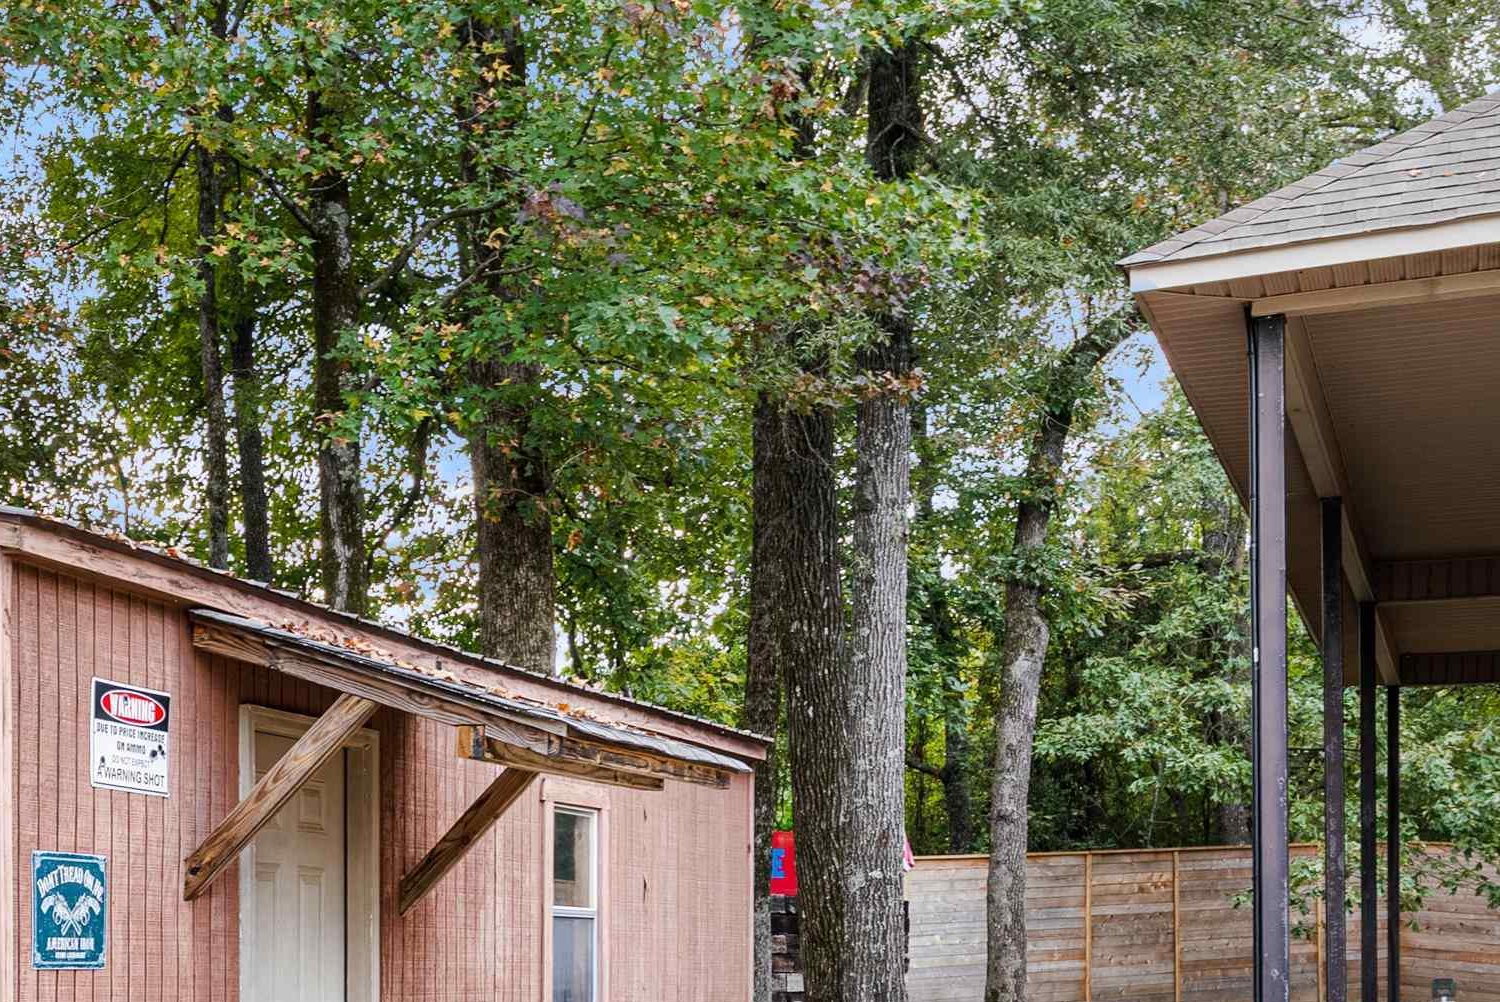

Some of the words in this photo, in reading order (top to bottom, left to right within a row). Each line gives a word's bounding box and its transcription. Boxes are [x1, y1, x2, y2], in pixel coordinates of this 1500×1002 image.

[97, 722, 108, 734] DUE
[110, 725, 117, 736] TO
[118, 727, 136, 739] PRICE
[105, 767, 142, 784] WARNING
[144, 772, 165, 787] SHOT
